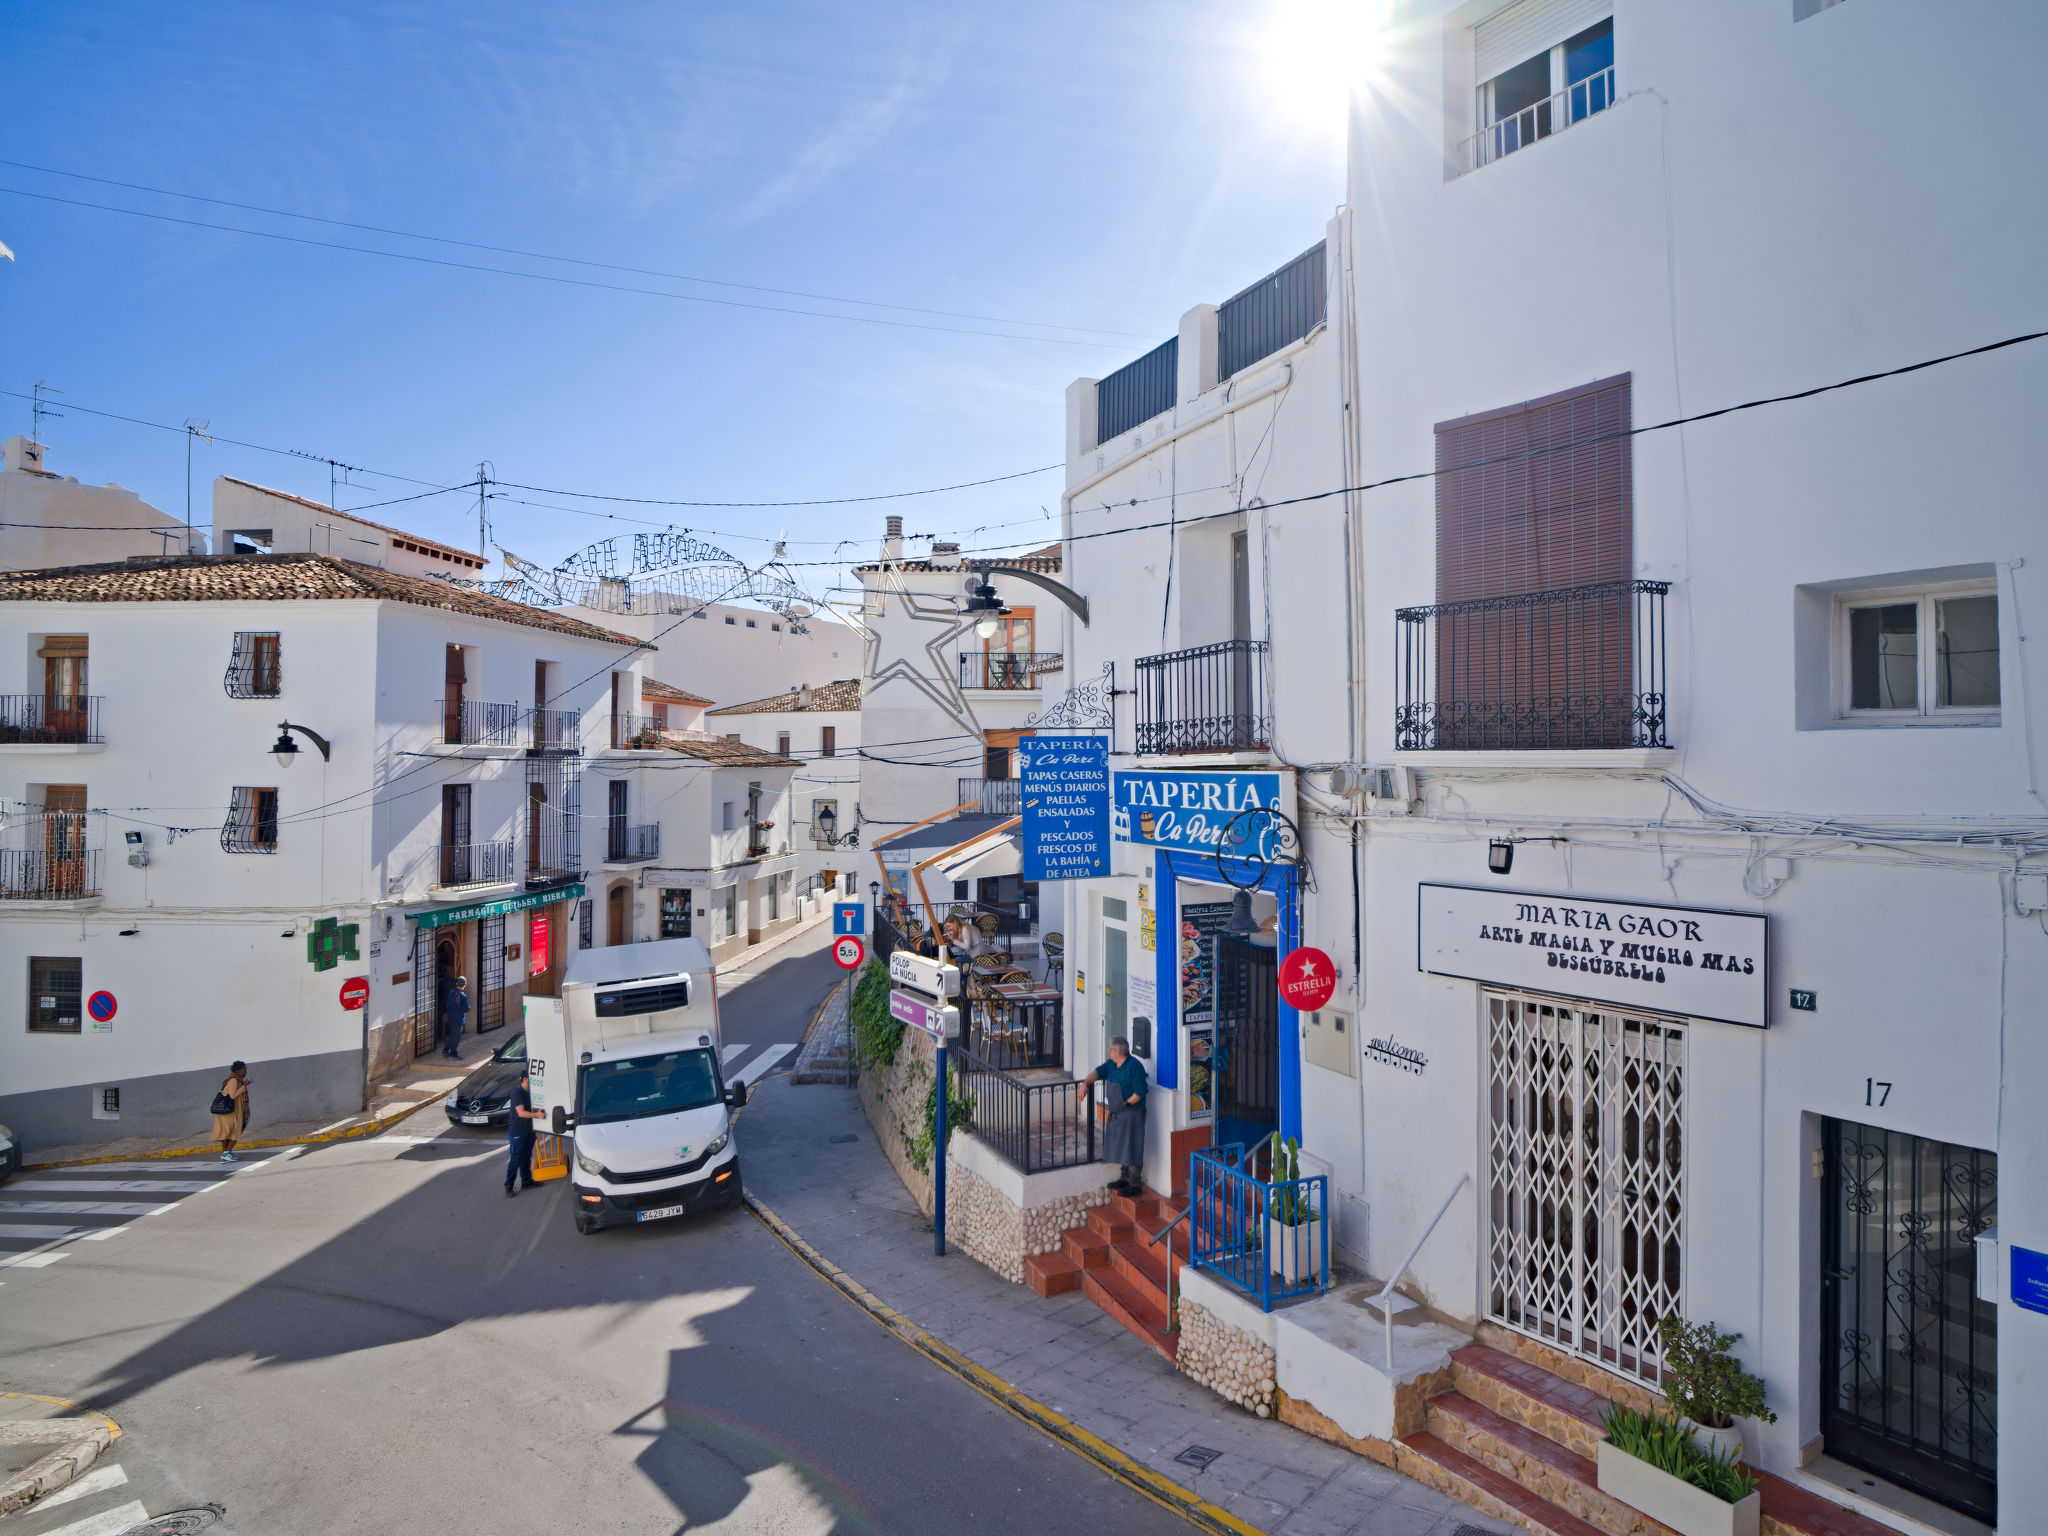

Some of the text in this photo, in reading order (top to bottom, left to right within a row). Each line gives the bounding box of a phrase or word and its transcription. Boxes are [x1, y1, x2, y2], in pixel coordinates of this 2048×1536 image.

[1023, 739, 1104, 750] TAPERÍA
[1036, 753, 1095, 766] Ca Pere
[1027, 770, 1103, 781] TAPAS CASERAS
[1024, 781, 1106, 793] MENÚS DIARIOS
[1046, 795, 1087, 805] PAELLAS
[1123, 777, 1262, 812] TAPERÍA
[1038, 807, 1095, 818] ENSALADAS
[1063, 820, 1071, 829] Y
[1154, 811, 1183, 842] Ca
[1040, 831, 1094, 842] PESCADOS
[1037, 843, 1097, 855] FRESCOS DE
[1045, 854, 1091, 867] LA BAHÍA
[1046, 868, 1091, 879] DE ALTEA
[449, 906, 496, 921] FARMACIA
[542, 891, 566, 903] RIERA
[1515, 903, 1705, 942] MARIA GAOR
[1479, 925, 1754, 975] ARTE MAGIA Y MUCHO MAS
[892, 956, 910, 968] POLOP
[1547, 952, 1666, 984] DESCÚBRELO
[892, 967, 917, 983] LA NUCIA
[1288, 976, 1332, 994] ESTRELLA
[1796, 993, 1810, 1007] 17
[1370, 1034, 1428, 1064] welcome
[1865, 1077, 1892, 1107] 17
